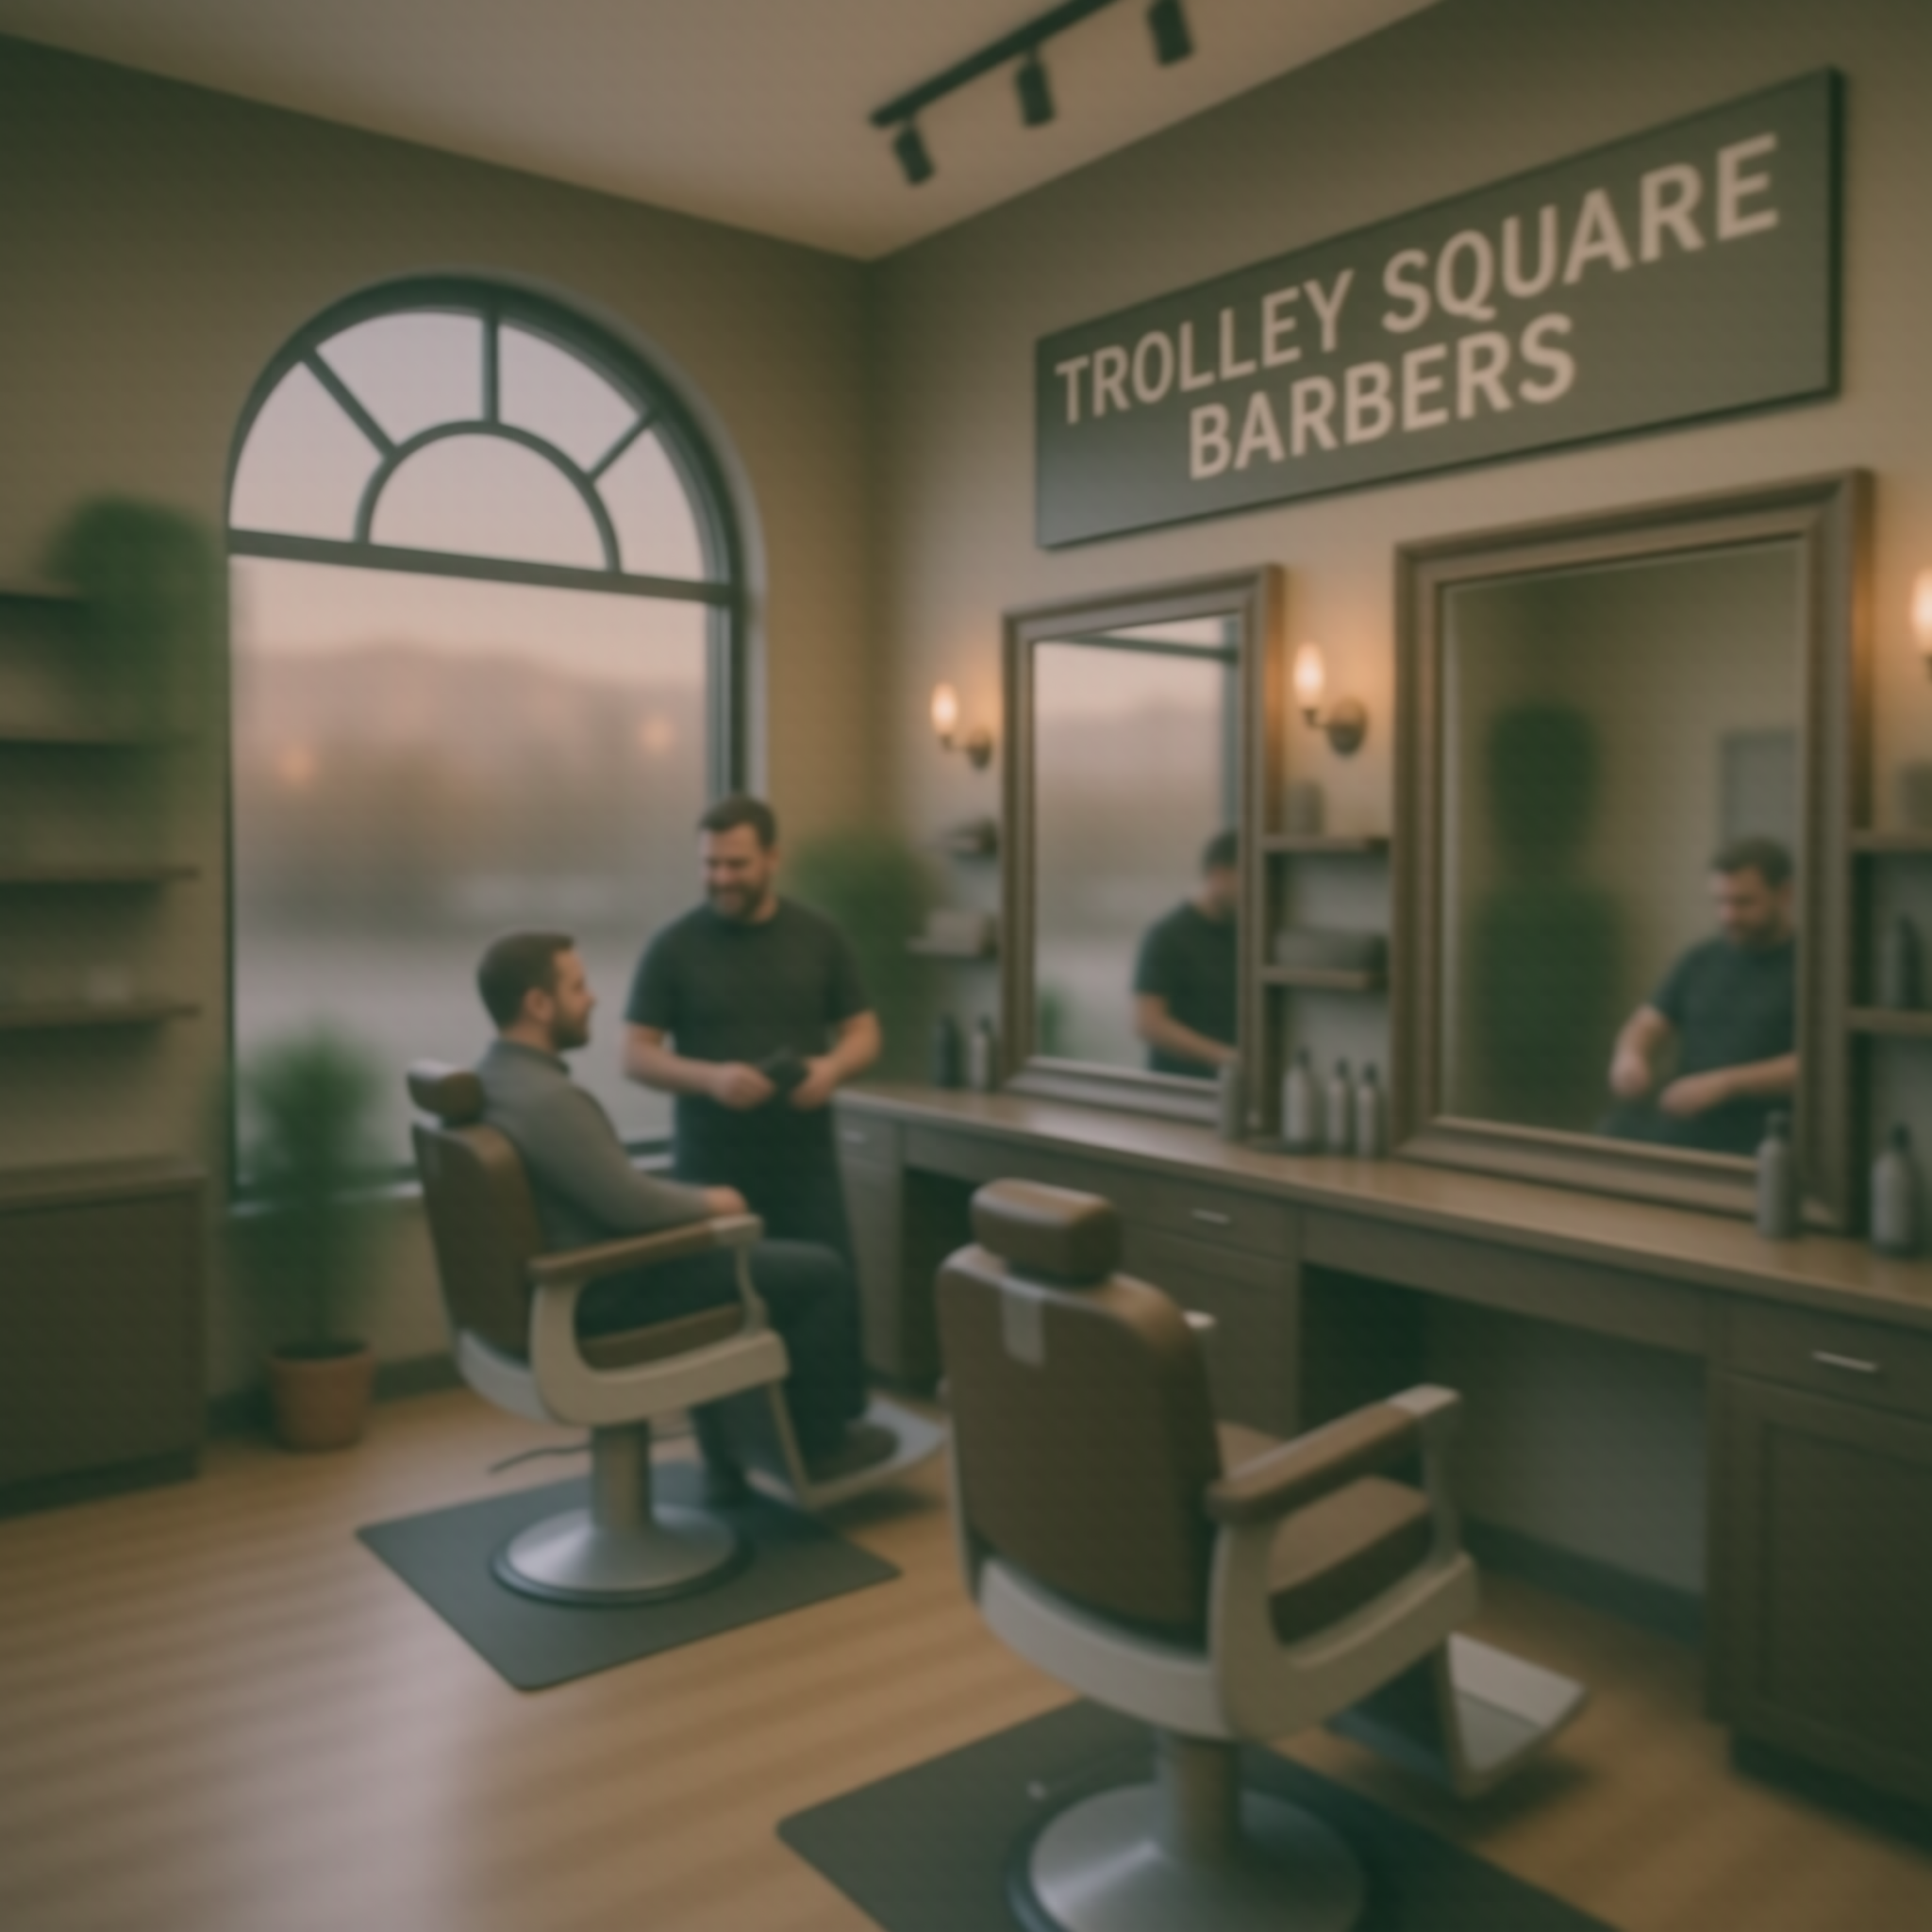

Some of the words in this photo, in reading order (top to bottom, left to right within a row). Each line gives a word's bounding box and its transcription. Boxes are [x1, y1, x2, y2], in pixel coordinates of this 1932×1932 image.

[1054, 270, 1354, 425] TROLLEY
[1380, 132, 1779, 334] SQUARE
[1188, 311, 1575, 481] BARBERS
